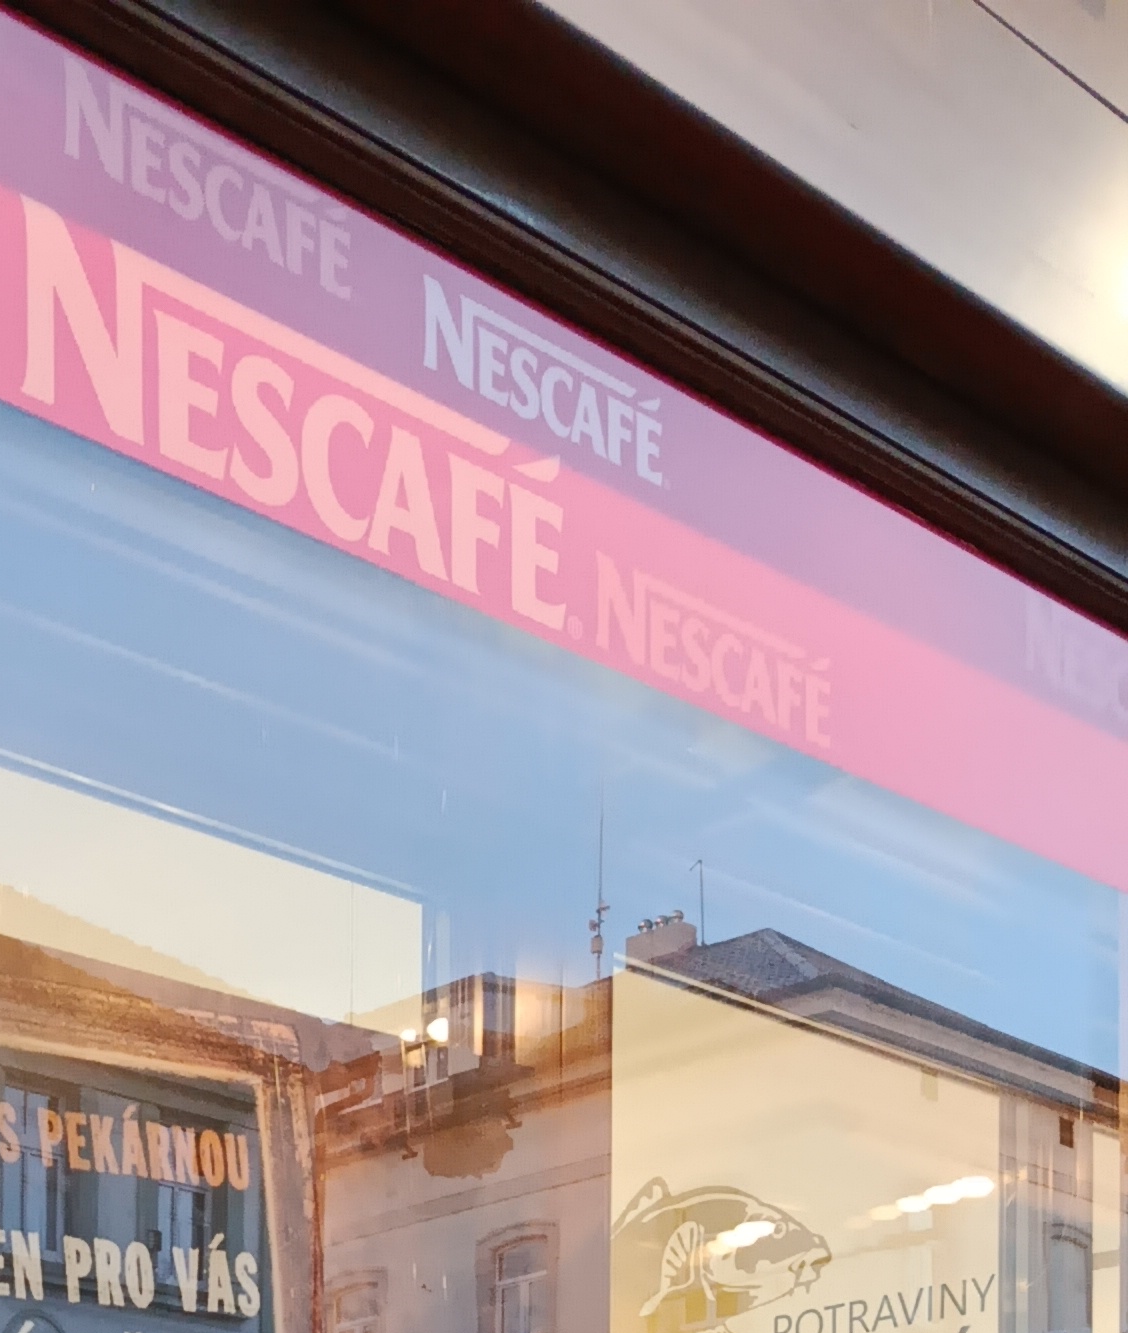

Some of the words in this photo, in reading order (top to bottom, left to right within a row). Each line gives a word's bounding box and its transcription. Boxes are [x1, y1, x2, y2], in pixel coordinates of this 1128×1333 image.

[64, 51, 353, 301] NESCAFÉ
[19, 192, 566, 640] NESCAFÉ
[422, 273, 664, 487] NESCAFÉ
[595, 549, 833, 750] NESCAFÉ
[37, 1102, 250, 1191] PEKÁRNOU
[62, 1235, 155, 1309] PRO
[172, 1232, 260, 1317] VÁS
